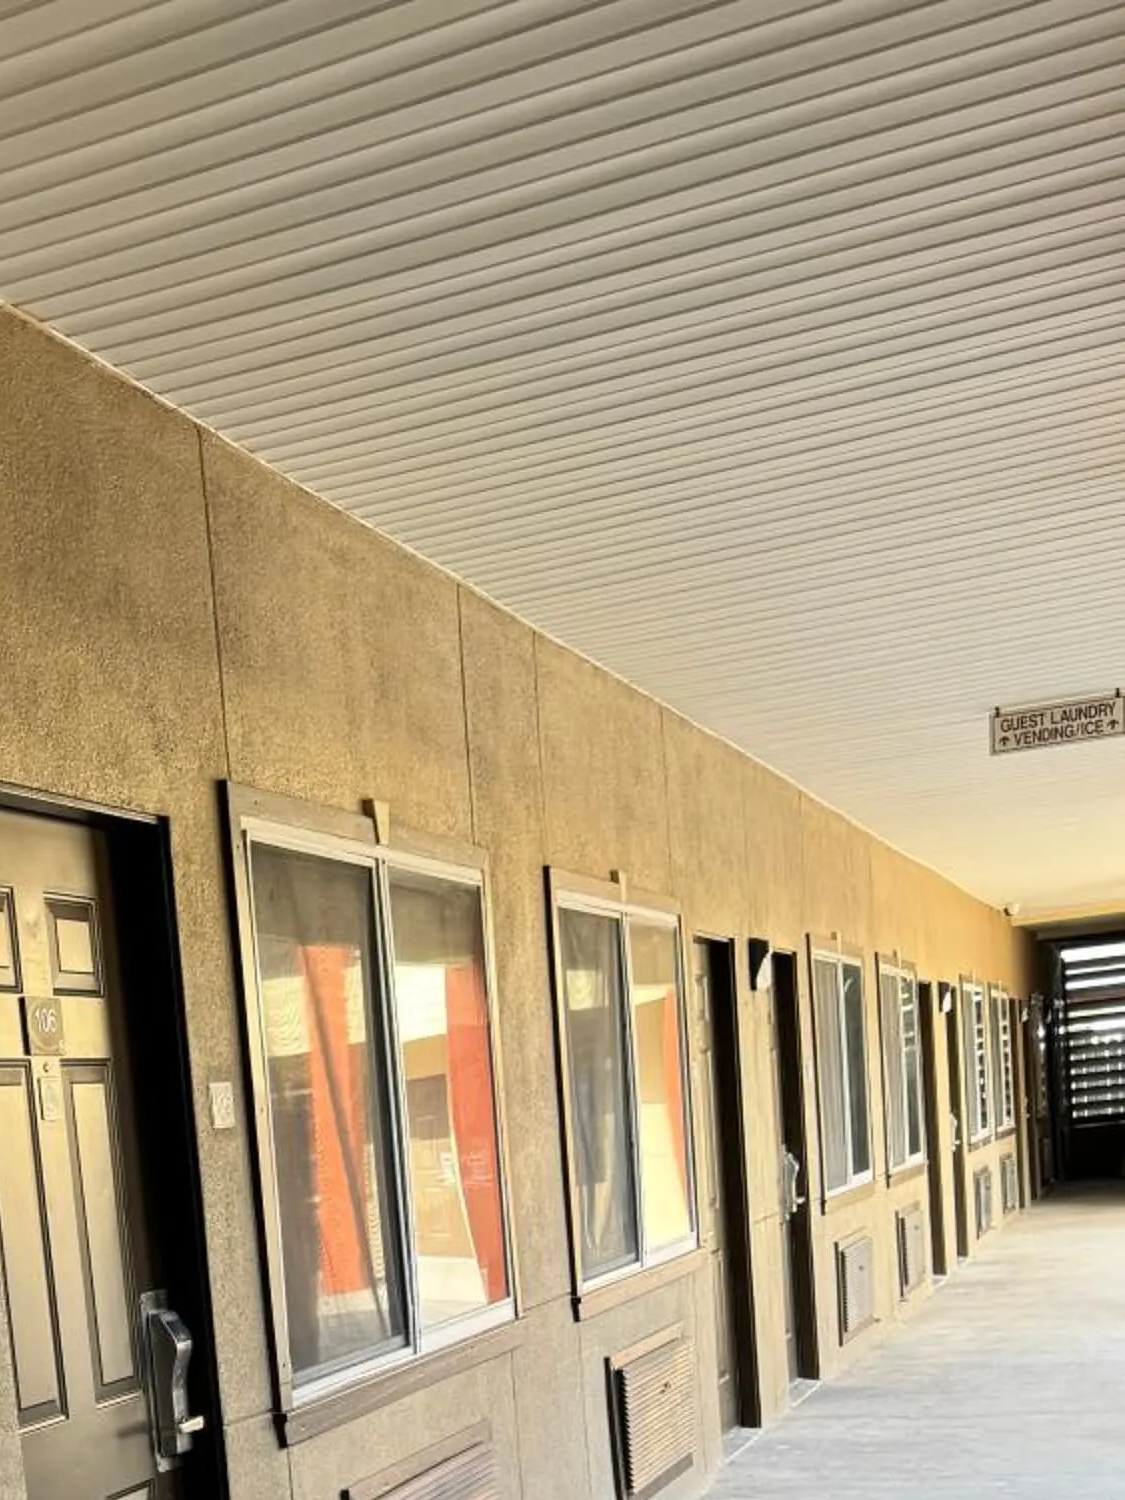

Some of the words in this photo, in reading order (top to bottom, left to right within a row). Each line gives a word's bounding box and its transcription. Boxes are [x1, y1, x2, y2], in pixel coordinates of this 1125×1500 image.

[1000, 713, 1044, 733] GUEST
[1050, 701, 1116, 725] LAUNDRY
[1013, 719, 1104, 746] VENDING/ICE
[34, 1007, 57, 1033] 106
